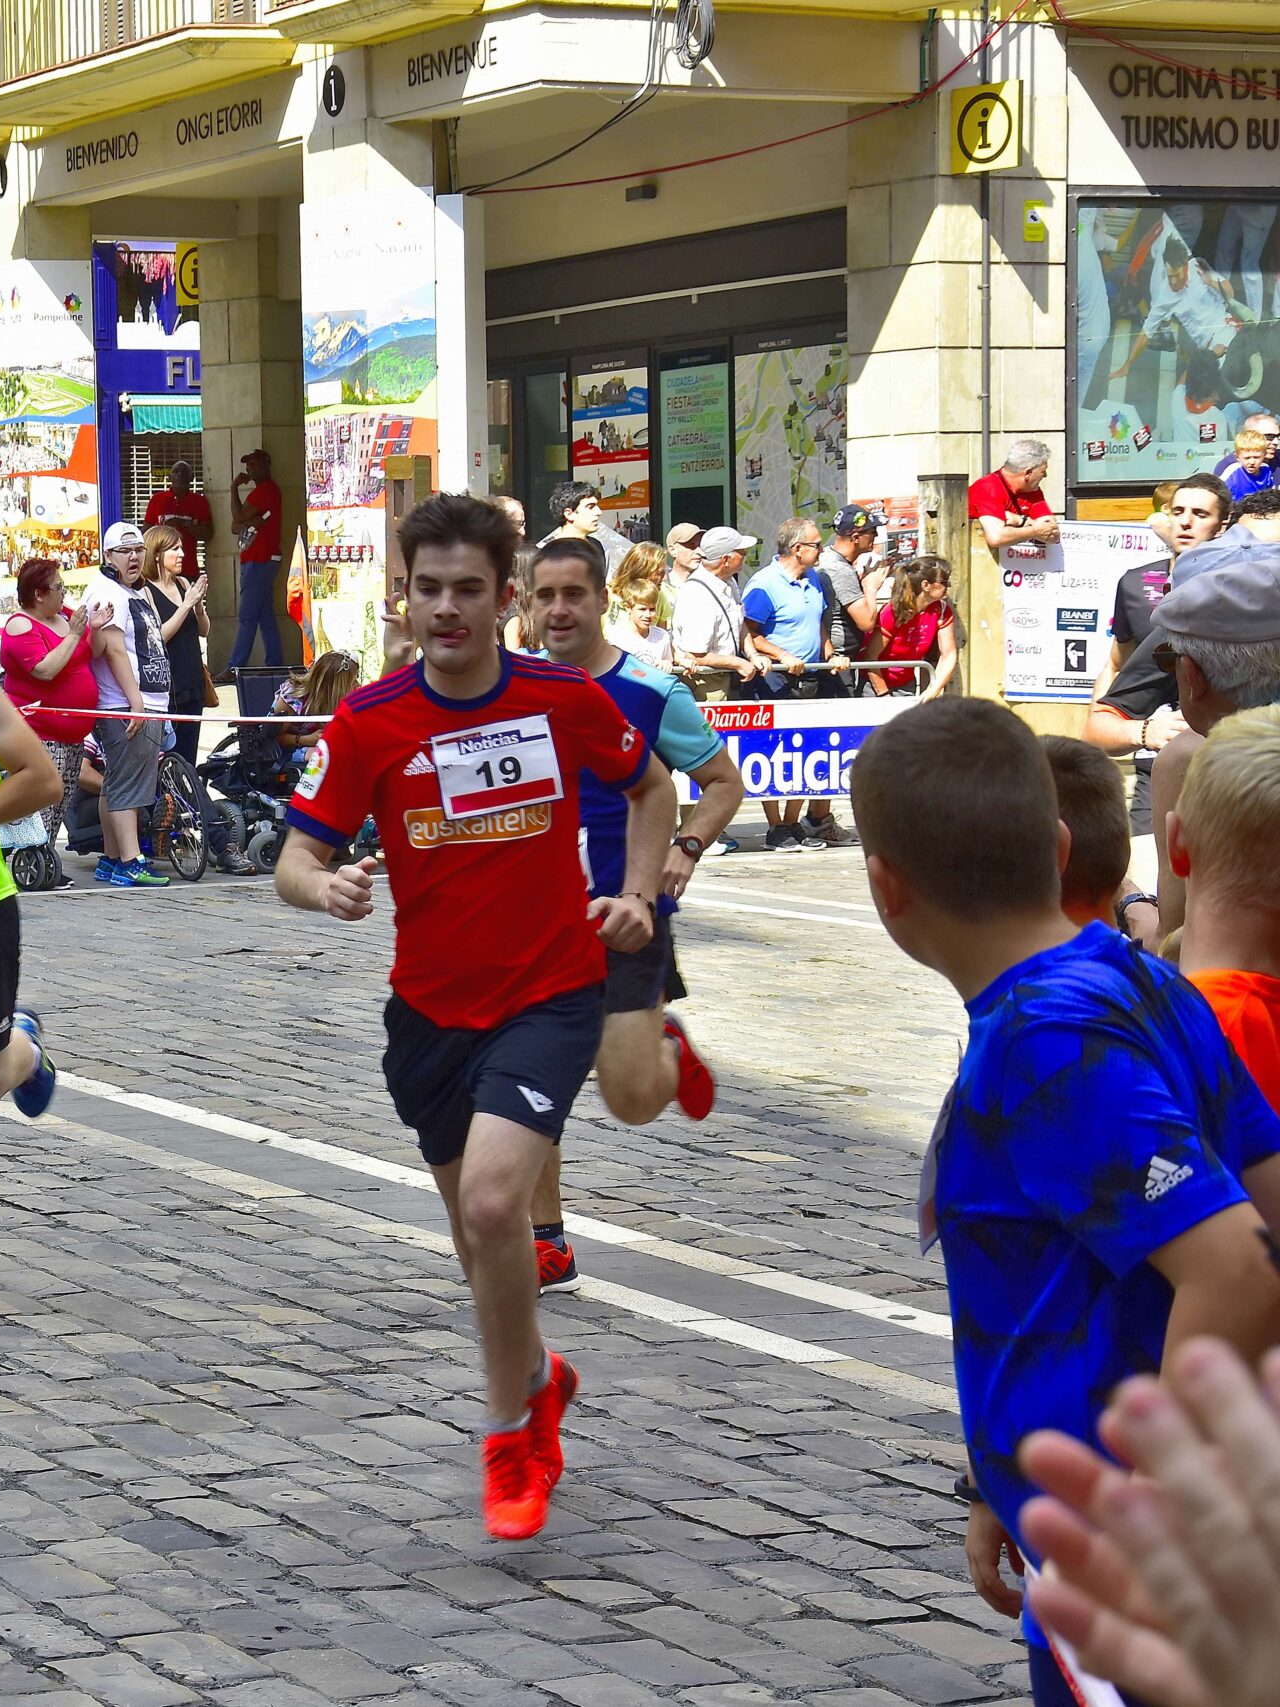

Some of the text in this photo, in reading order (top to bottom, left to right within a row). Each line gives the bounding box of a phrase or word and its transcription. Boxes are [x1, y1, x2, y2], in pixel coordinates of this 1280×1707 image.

[407, 36, 497, 88] BIENVENUE
[1108, 63, 1223, 99] OFICINA
[1231, 67, 1267, 100] DE
[66, 98, 263, 173] BIENVENIDO ONGI ETORRI
[1121, 115, 1280, 150] TURISMO BU
[33, 312, 83, 323] Pampelune
[666, 395, 692, 410] FIESTA
[667, 433, 709, 447] CATHEDRAL
[680, 458, 725, 474] ENTZIERROA
[1014, 549, 1047, 560] YAMAHA
[1121, 534, 1149, 551] IBILI
[703, 705, 771, 729] Diario de
[459, 733, 520, 756] Noticias
[476, 756, 522, 788] 19
[410, 808, 526, 841] euskaltel
[1145, 1165, 1194, 1201] adidas
